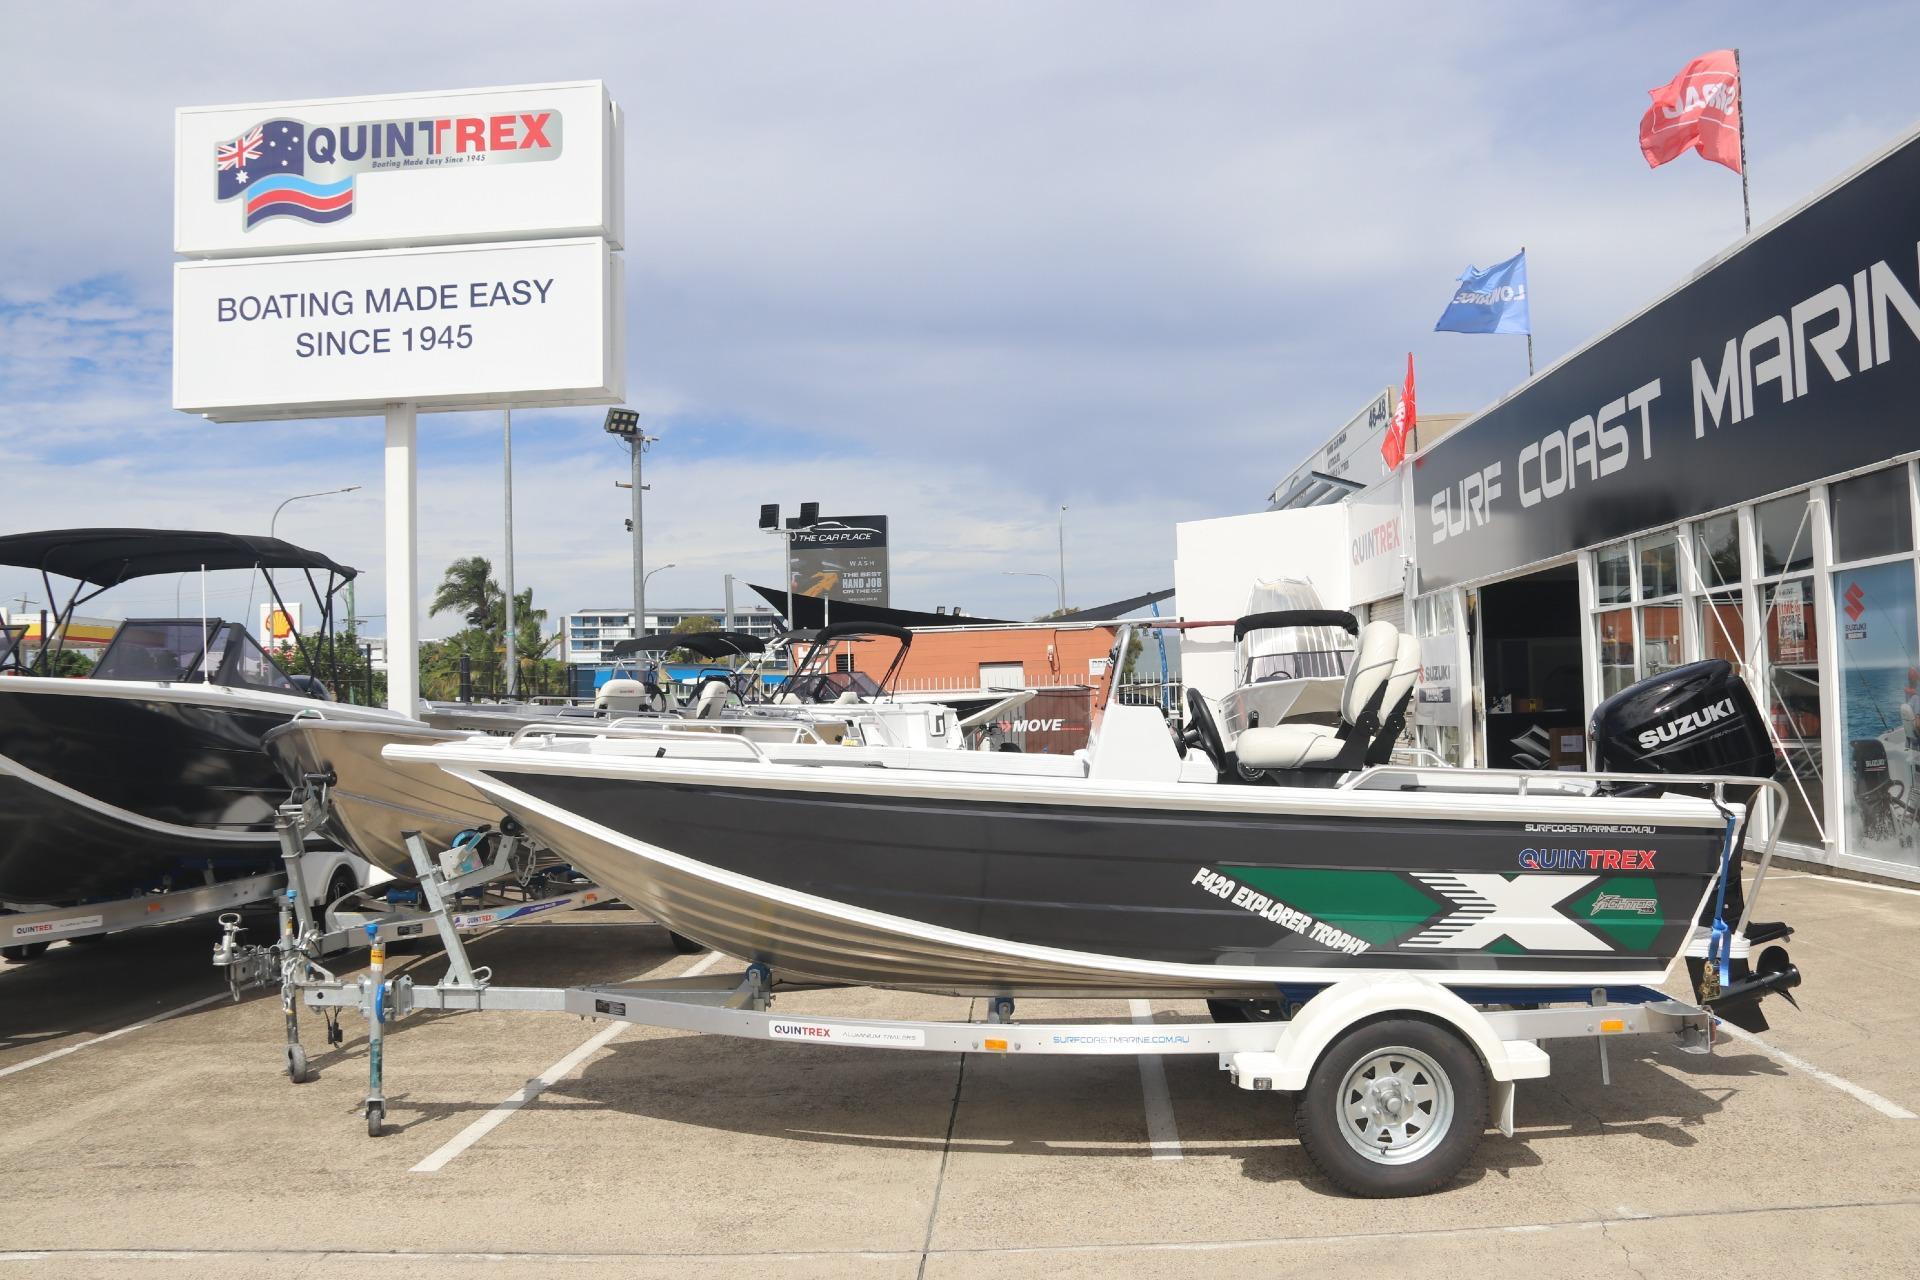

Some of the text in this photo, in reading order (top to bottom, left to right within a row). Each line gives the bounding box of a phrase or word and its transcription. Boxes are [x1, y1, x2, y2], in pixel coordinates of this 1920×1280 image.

[307, 113, 552, 164] QUINTREX
[372, 160, 400, 168] Boating
[426, 157, 442, 165] Easy
[467, 154, 486, 162] 1945
[218, 279, 554, 322] BOATING MADE EASY
[295, 324, 473, 358] SINCE 1945
[1432, 462, 1501, 545] SURF
[1518, 378, 1661, 508] COAST
[800, 533, 873, 542] THE CAR PLACE
[1352, 517, 1400, 566] QUINTREX
[843, 577, 882, 588] HAND JOB
[1845, 623, 1867, 632] SUZUKI
[1426, 665, 1450, 681] SUZUKI
[1012, 719, 1064, 732] MOVE
[1638, 698, 1736, 749] SUZUKI
[1525, 823, 1656, 834] SURFCOASTMARINE.COM.AU
[1518, 848, 1657, 870] QUINTREX
[1191, 867, 1371, 956] F420 EXPLORER TROPHY
[16, 924, 53, 934] QUINTREX
[774, 1025, 831, 1037] QUINTREX
[1053, 1035, 1190, 1044] SURFCOASTMARINE.COM.AU
